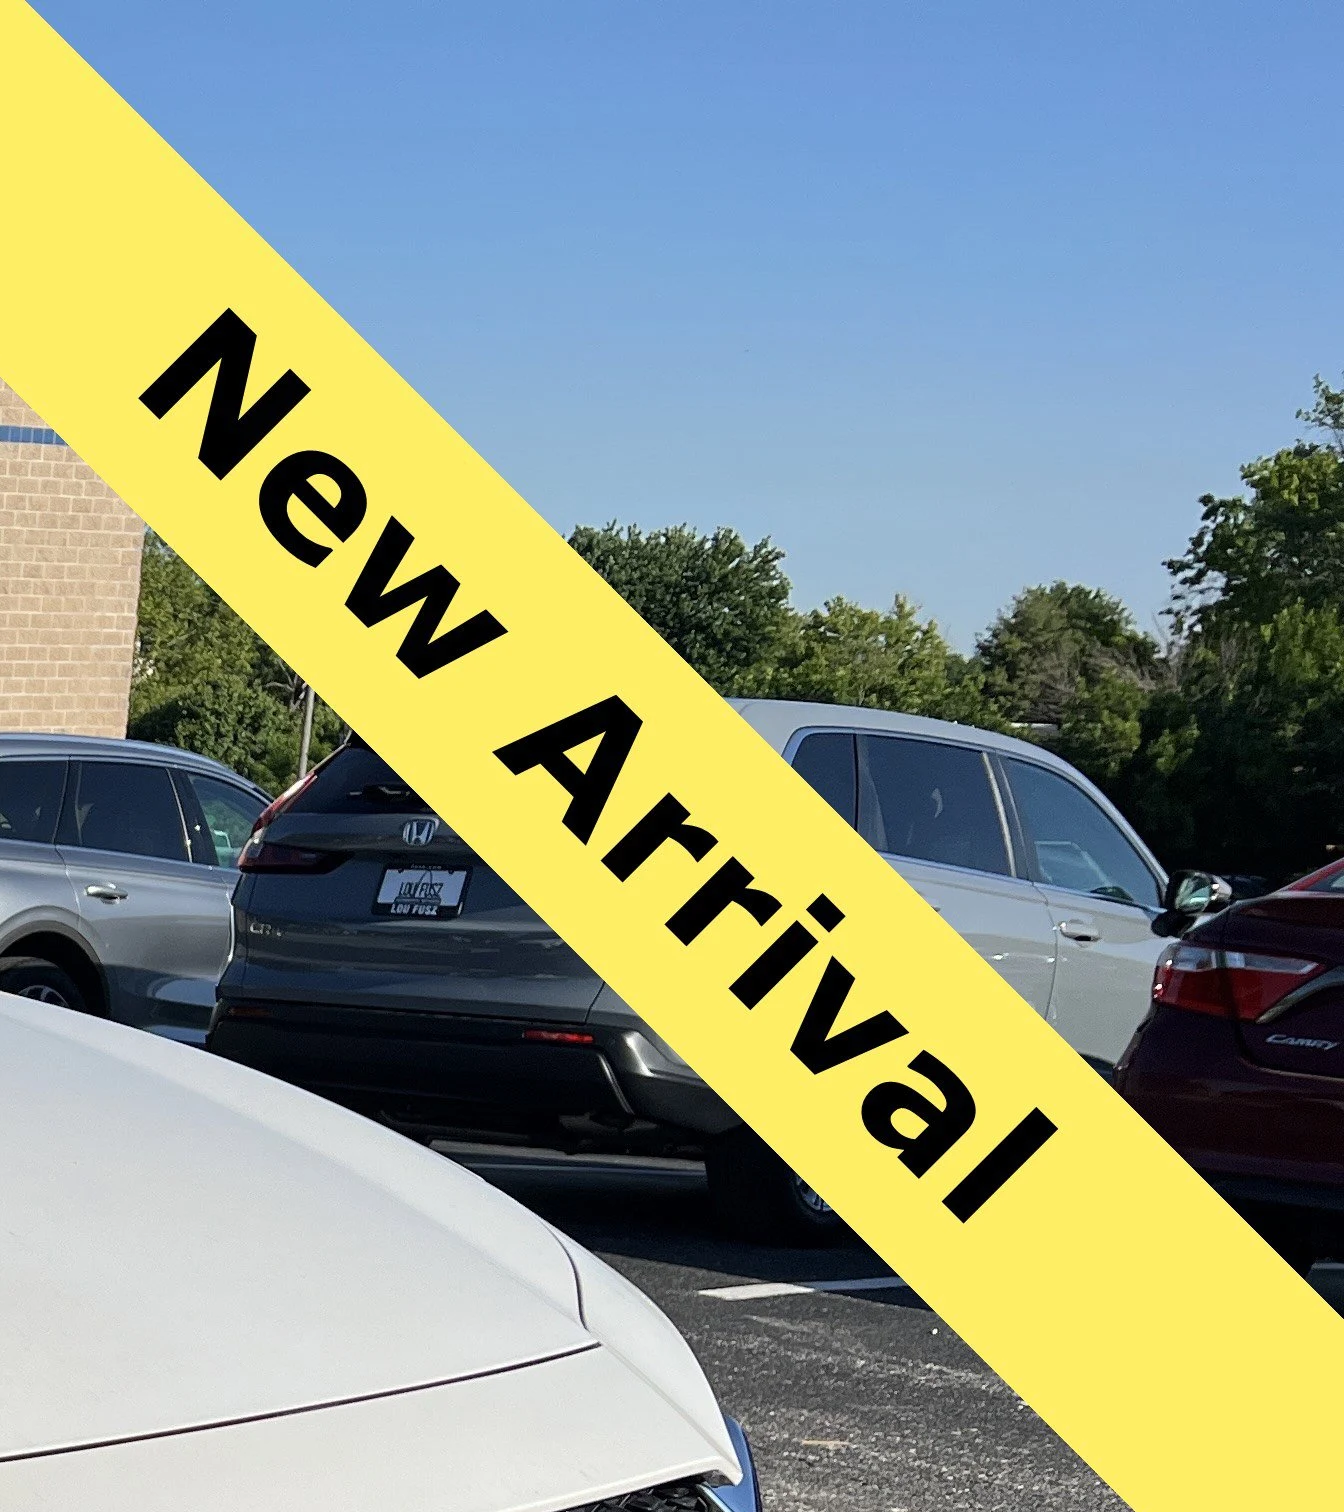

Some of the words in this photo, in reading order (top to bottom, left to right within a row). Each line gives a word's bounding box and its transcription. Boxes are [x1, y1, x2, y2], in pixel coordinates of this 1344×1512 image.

[391, 903, 411, 914] LOU
[412, 904, 438, 916] FUSZ
[1266, 1034, 1339, 1050] Camry
